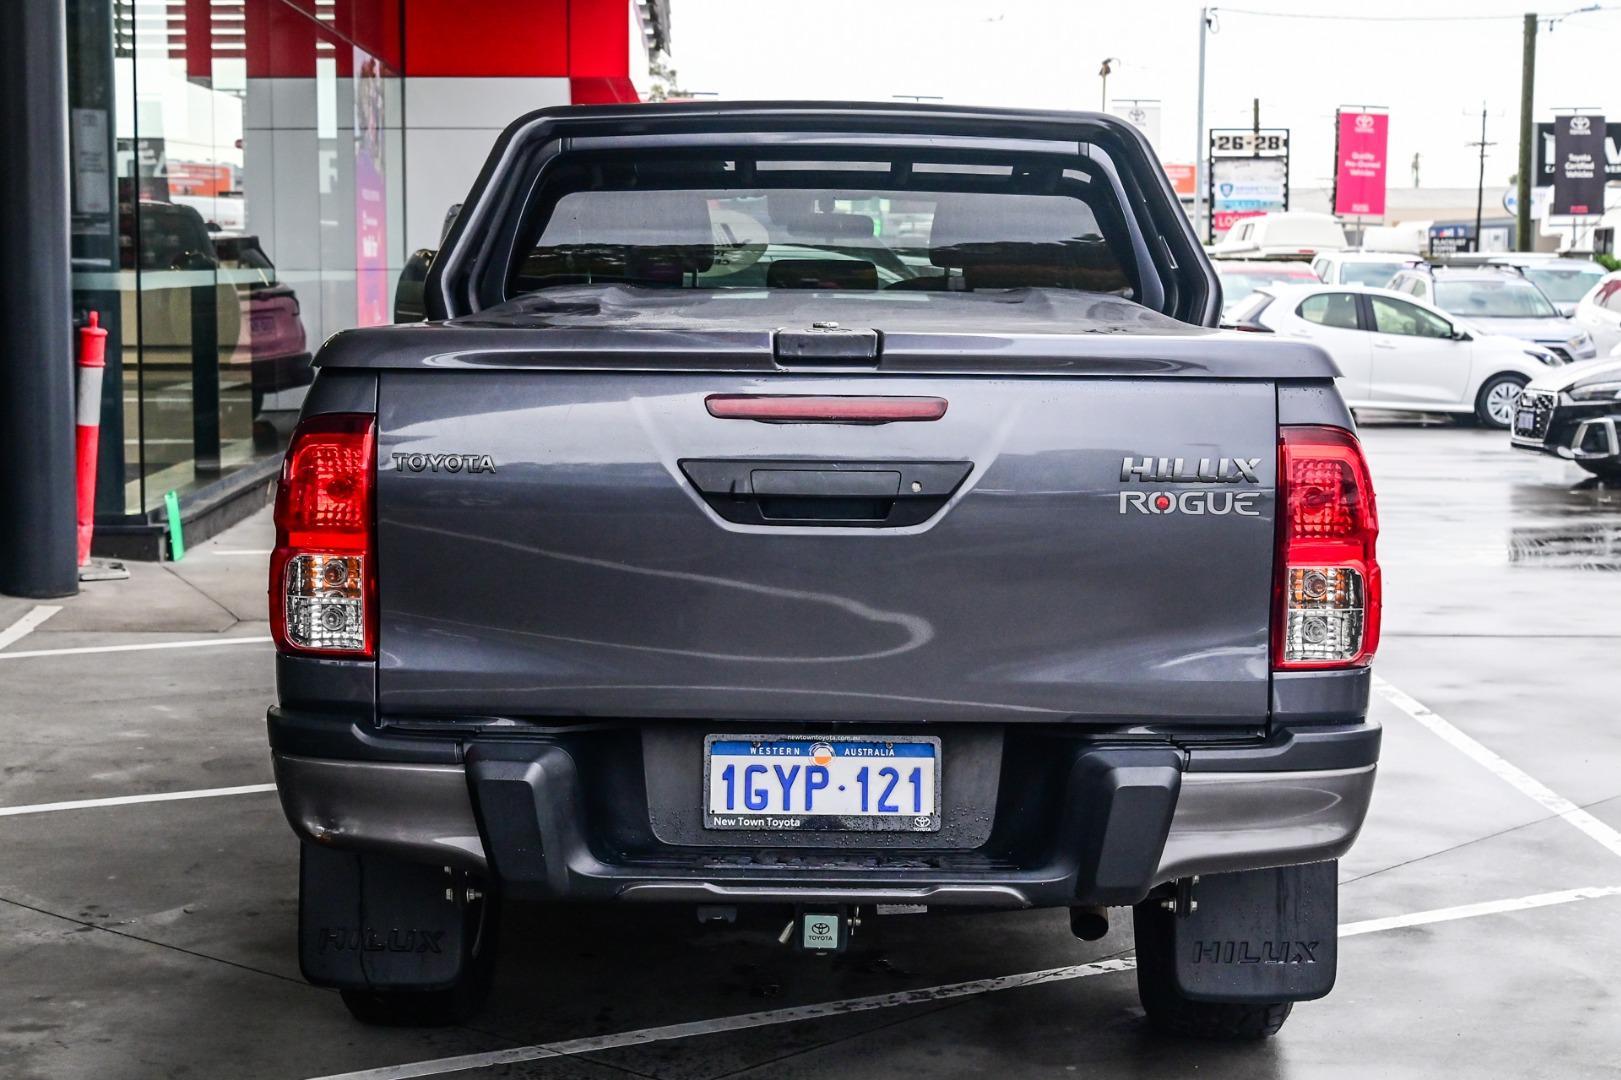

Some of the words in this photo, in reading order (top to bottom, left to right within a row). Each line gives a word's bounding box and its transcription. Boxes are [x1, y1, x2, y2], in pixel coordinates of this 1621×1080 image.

[1218, 136, 1280, 150] 26-28
[391, 453, 497, 474] TOYOTA
[1119, 457, 1262, 483] HILUX
[1119, 491, 1261, 516] ROGUE
[750, 747, 800, 755] WESTERN
[844, 748, 895, 756] AUSTRALIA
[713, 817, 736, 826] New
[738, 817, 765, 826] Town
[766, 818, 801, 828] Toyota
[319, 927, 447, 955] HILUX
[1192, 941, 1320, 964] HILUX
